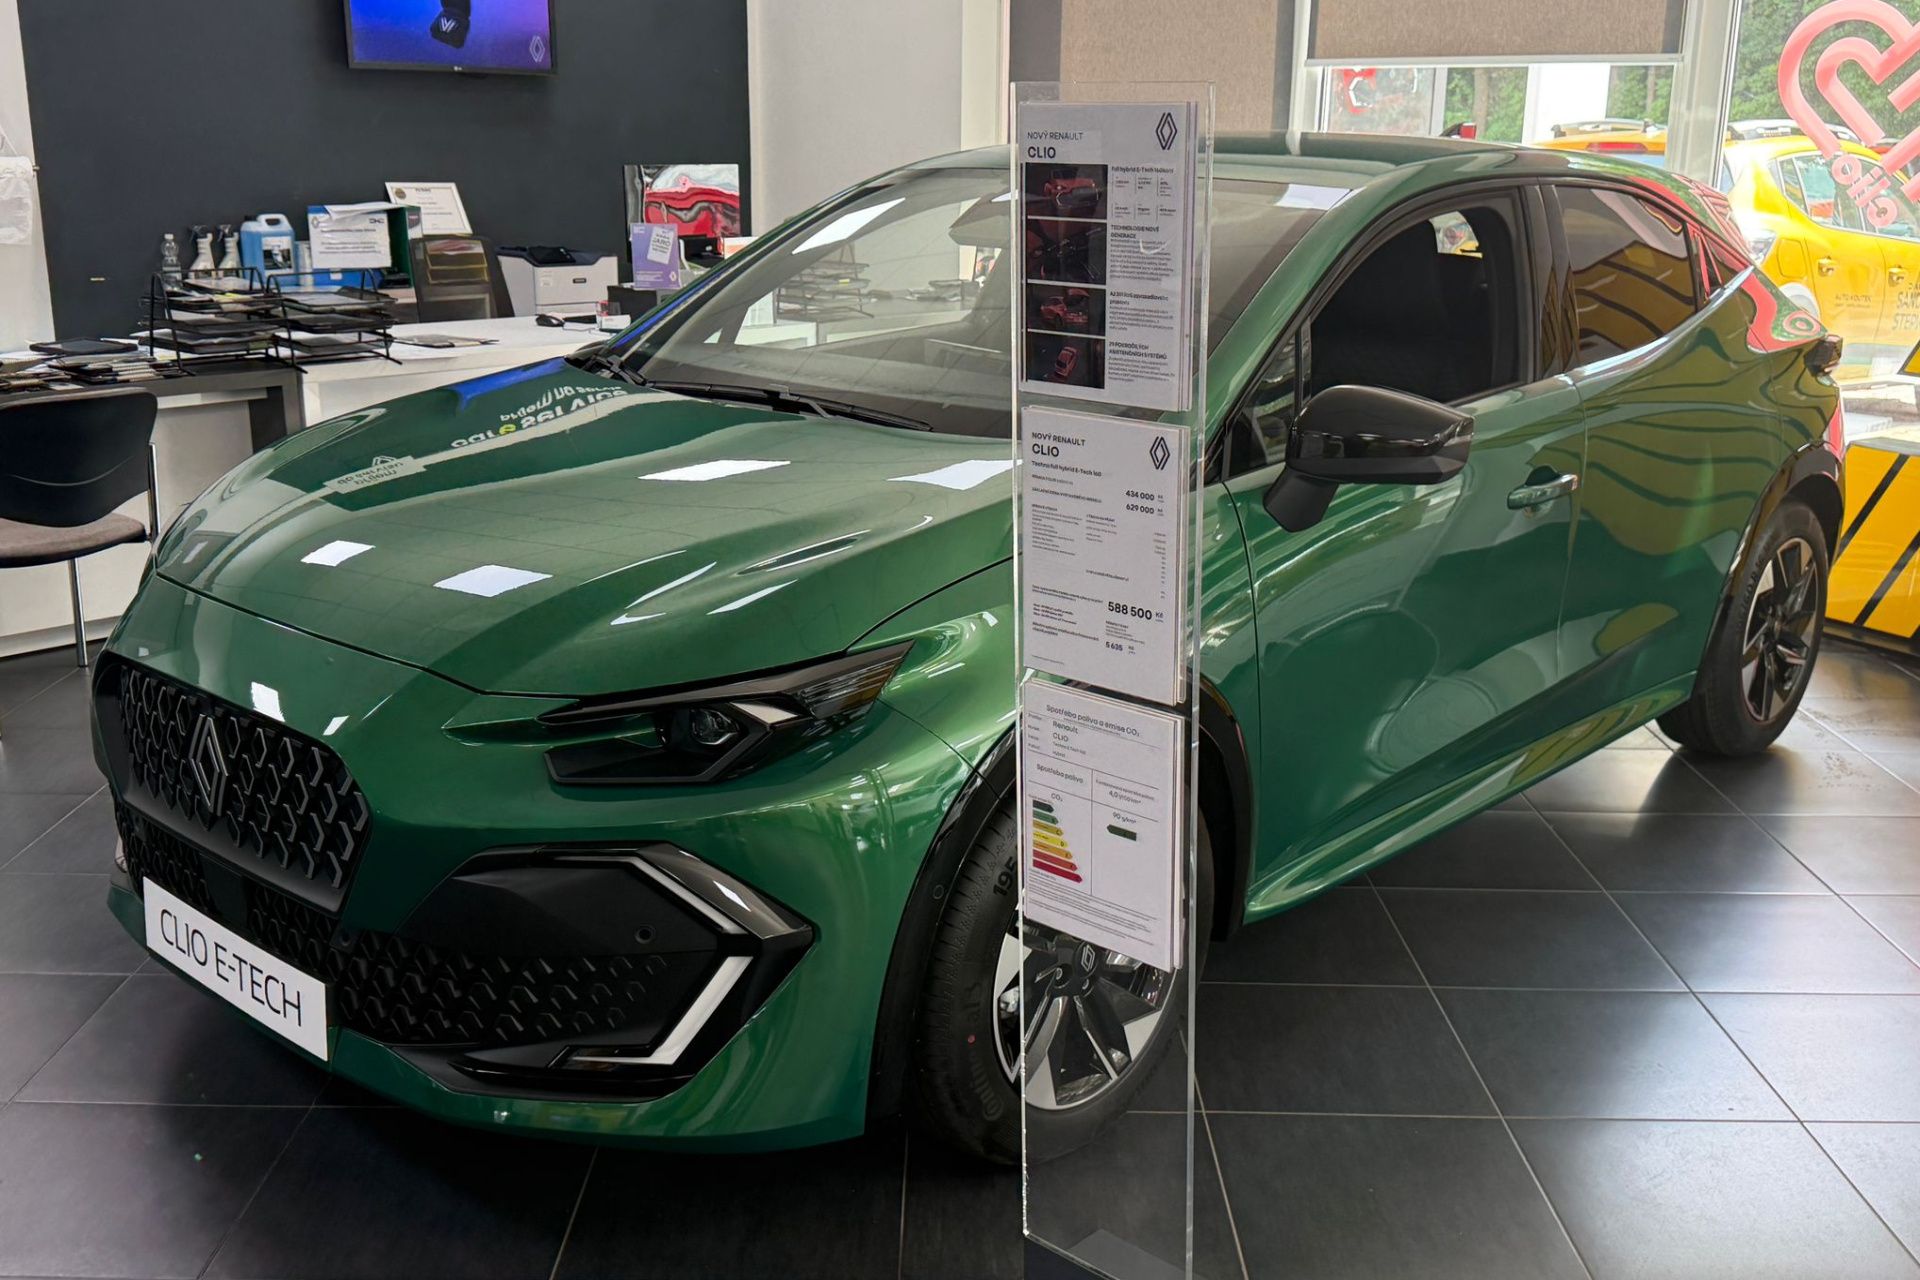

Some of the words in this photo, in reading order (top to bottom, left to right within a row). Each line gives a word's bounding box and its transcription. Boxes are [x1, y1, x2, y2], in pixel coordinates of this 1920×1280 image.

[1027, 130, 1049, 140] NOVÝ
[1050, 132, 1084, 141] RENAULT
[1027, 146, 1057, 159] CLIO
[1031, 432, 1052, 441] NOVÝ
[1052, 435, 1086, 446] RENAULT
[1032, 443, 1060, 457] CLIO
[1031, 460, 1050, 469] Techno
[1059, 464, 1075, 473] hybrid
[1075, 466, 1093, 476] E-Tech
[1126, 490, 1139, 498] 434
[1140, 492, 1155, 501] 000
[1126, 503, 1139, 512] 629
[1140, 505, 1155, 515] 000
[1107, 601, 1128, 615] 588
[1130, 606, 1152, 620] 500
[1046, 704, 1077, 719] Spotřeba
[1077, 714, 1098, 725] paliva
[1104, 722, 1126, 733] emise
[1052, 720, 1079, 735] Renault
[1052, 732, 1069, 742] CLIO
[1036, 763, 1064, 777] Spotřeba
[1064, 773, 1084, 784] paliva
[160, 908, 208, 967] CLIO
[213, 941, 302, 1028] E-TECH
